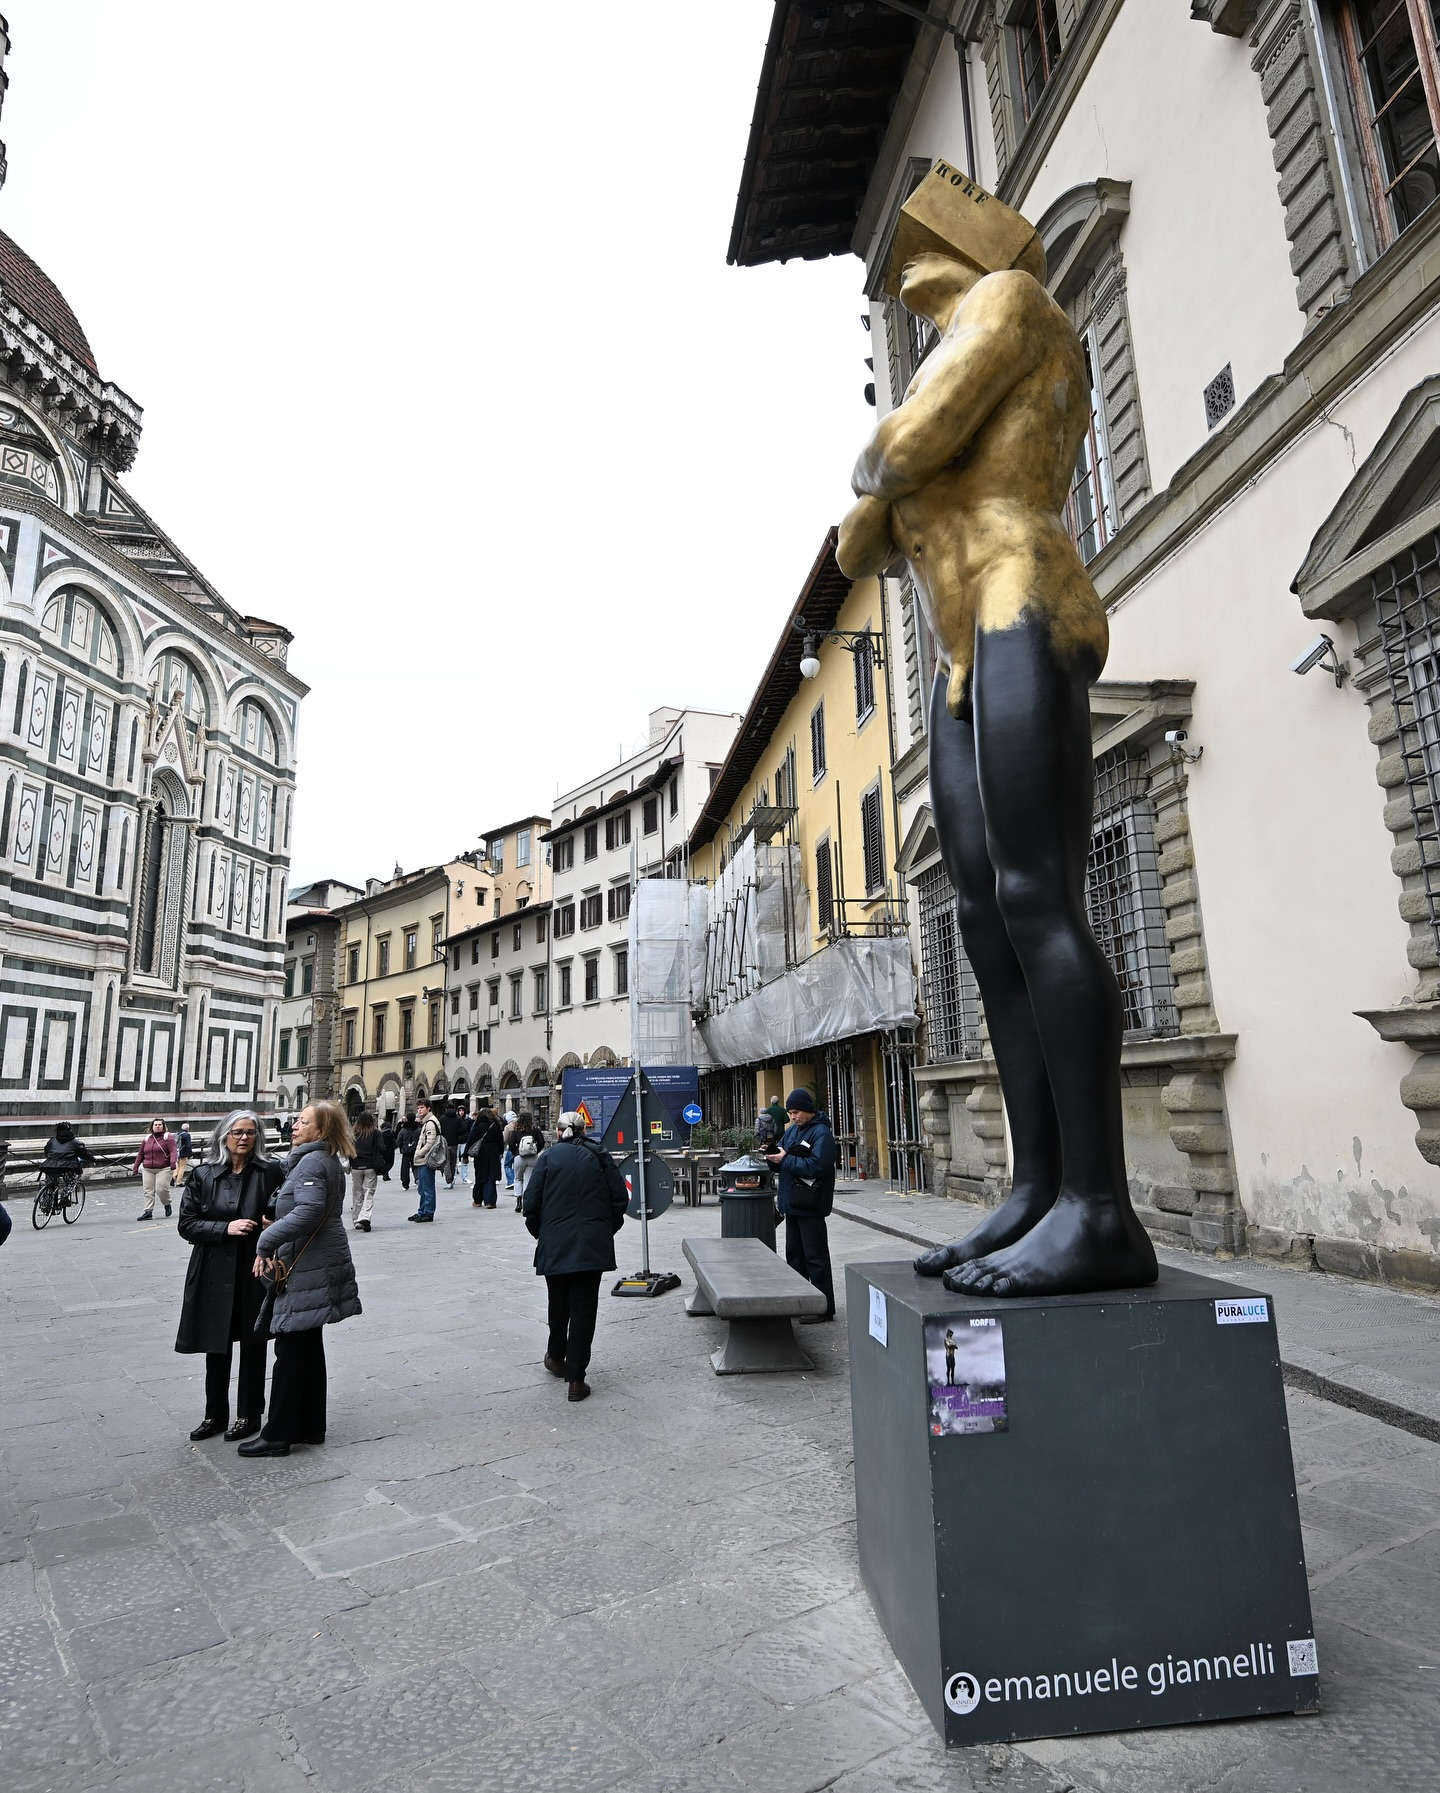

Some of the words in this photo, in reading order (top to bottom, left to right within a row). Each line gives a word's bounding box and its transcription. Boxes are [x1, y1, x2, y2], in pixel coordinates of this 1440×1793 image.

[1217, 1305, 1266, 1317] PURALUCE
[984, 1658, 1138, 1702] emanuele
[1147, 1643, 1275, 1695] giannelli
